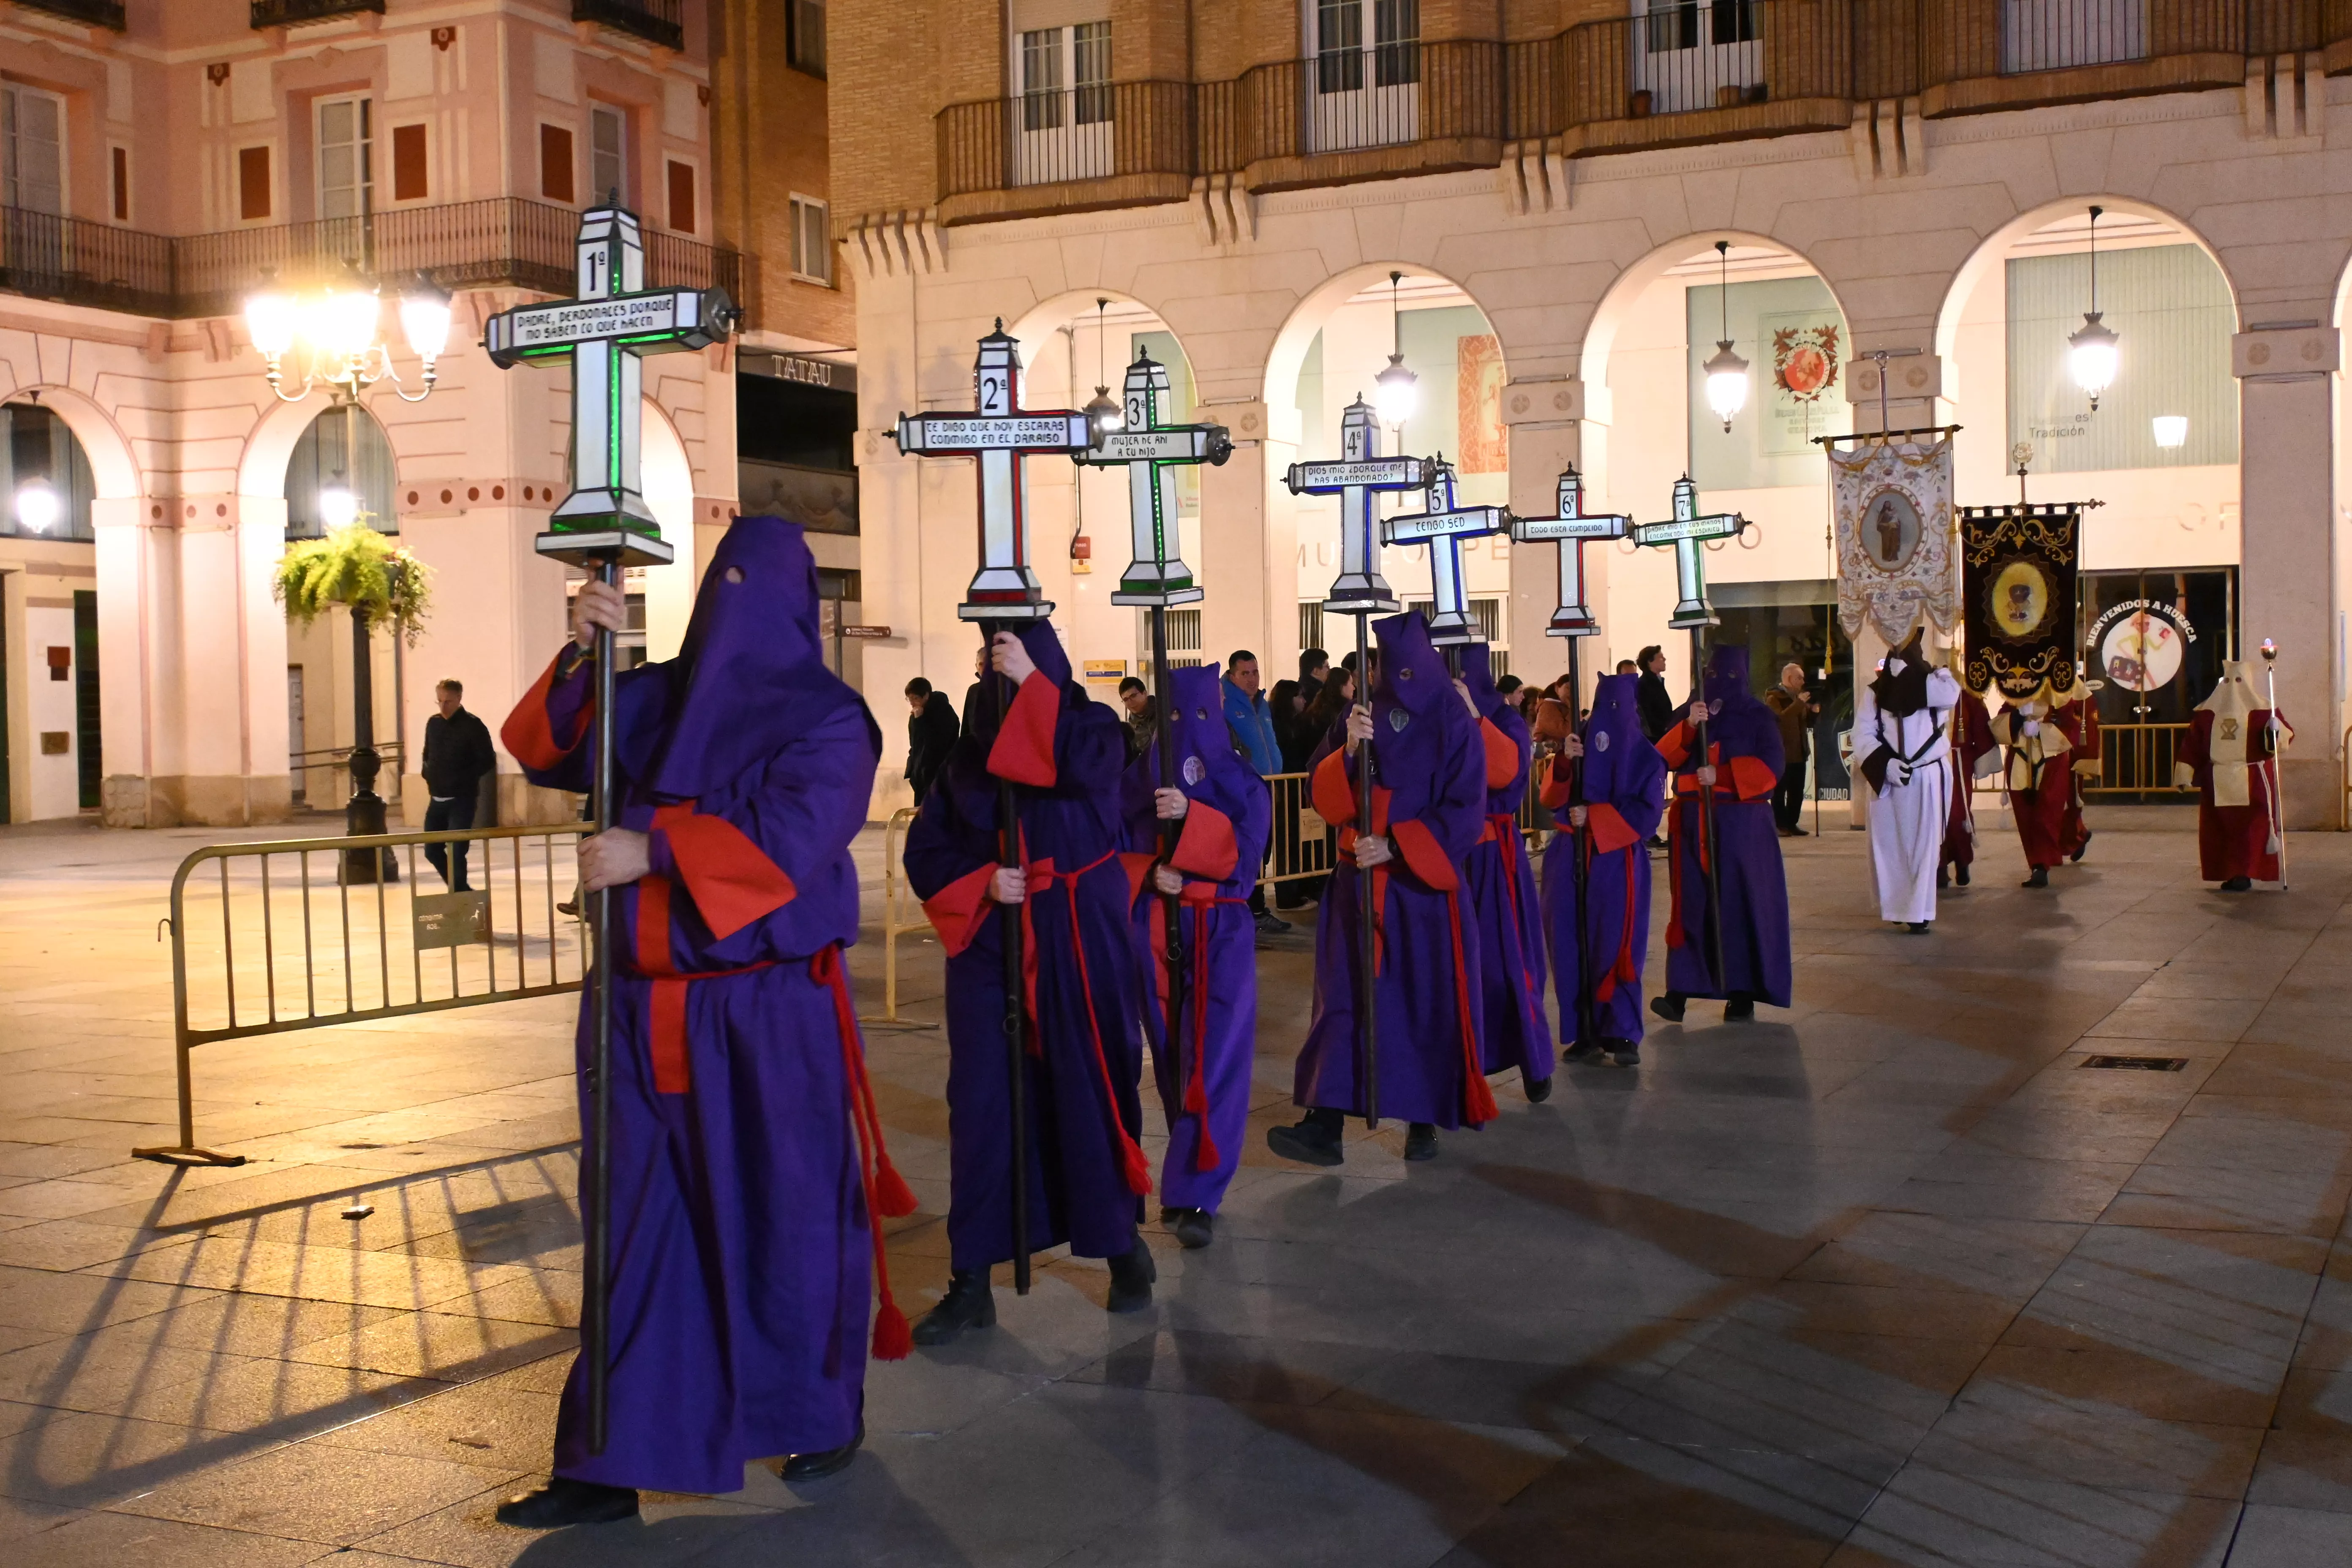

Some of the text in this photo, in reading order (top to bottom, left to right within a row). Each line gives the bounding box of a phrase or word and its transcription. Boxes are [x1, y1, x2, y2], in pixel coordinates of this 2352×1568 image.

[559, 304, 627, 323] PERDONALES
[629, 299, 673, 315] PORQUE
[525, 329, 541, 340] NO
[544, 325, 577, 338] SABEN
[581, 324, 592, 334] LO
[596, 320, 617, 332] QUE
[772, 354, 831, 387] TATAU
[926, 421, 1064, 433] TE DIGO QUE HOY ESTARAS
[2029, 425, 2085, 438] Tradición
[931, 433, 1060, 445] CONMIGO EN EL PARAISO
[1111, 436, 1139, 447] MUJER
[1118, 448, 1123, 457] A
[1127, 448, 1136, 457] TU
[1309, 463, 1402, 475] DIOS MIO ¿PORQUE ME
[1315, 473, 1394, 484] HAS ABANDONADO?
[1416, 517, 1465, 532] TENGO SED
[1568, 524, 1603, 533] CUMPLIDO
[1647, 525, 1665, 534] PADRE
[1650, 531, 1685, 540] ENCOMIENDO
[1695, 526, 1720, 534] ESPIRITU
[2086, 599, 2197, 647] BIENVENIDOS A HUESCA
[1819, 787, 1848, 800] CIUDAD
